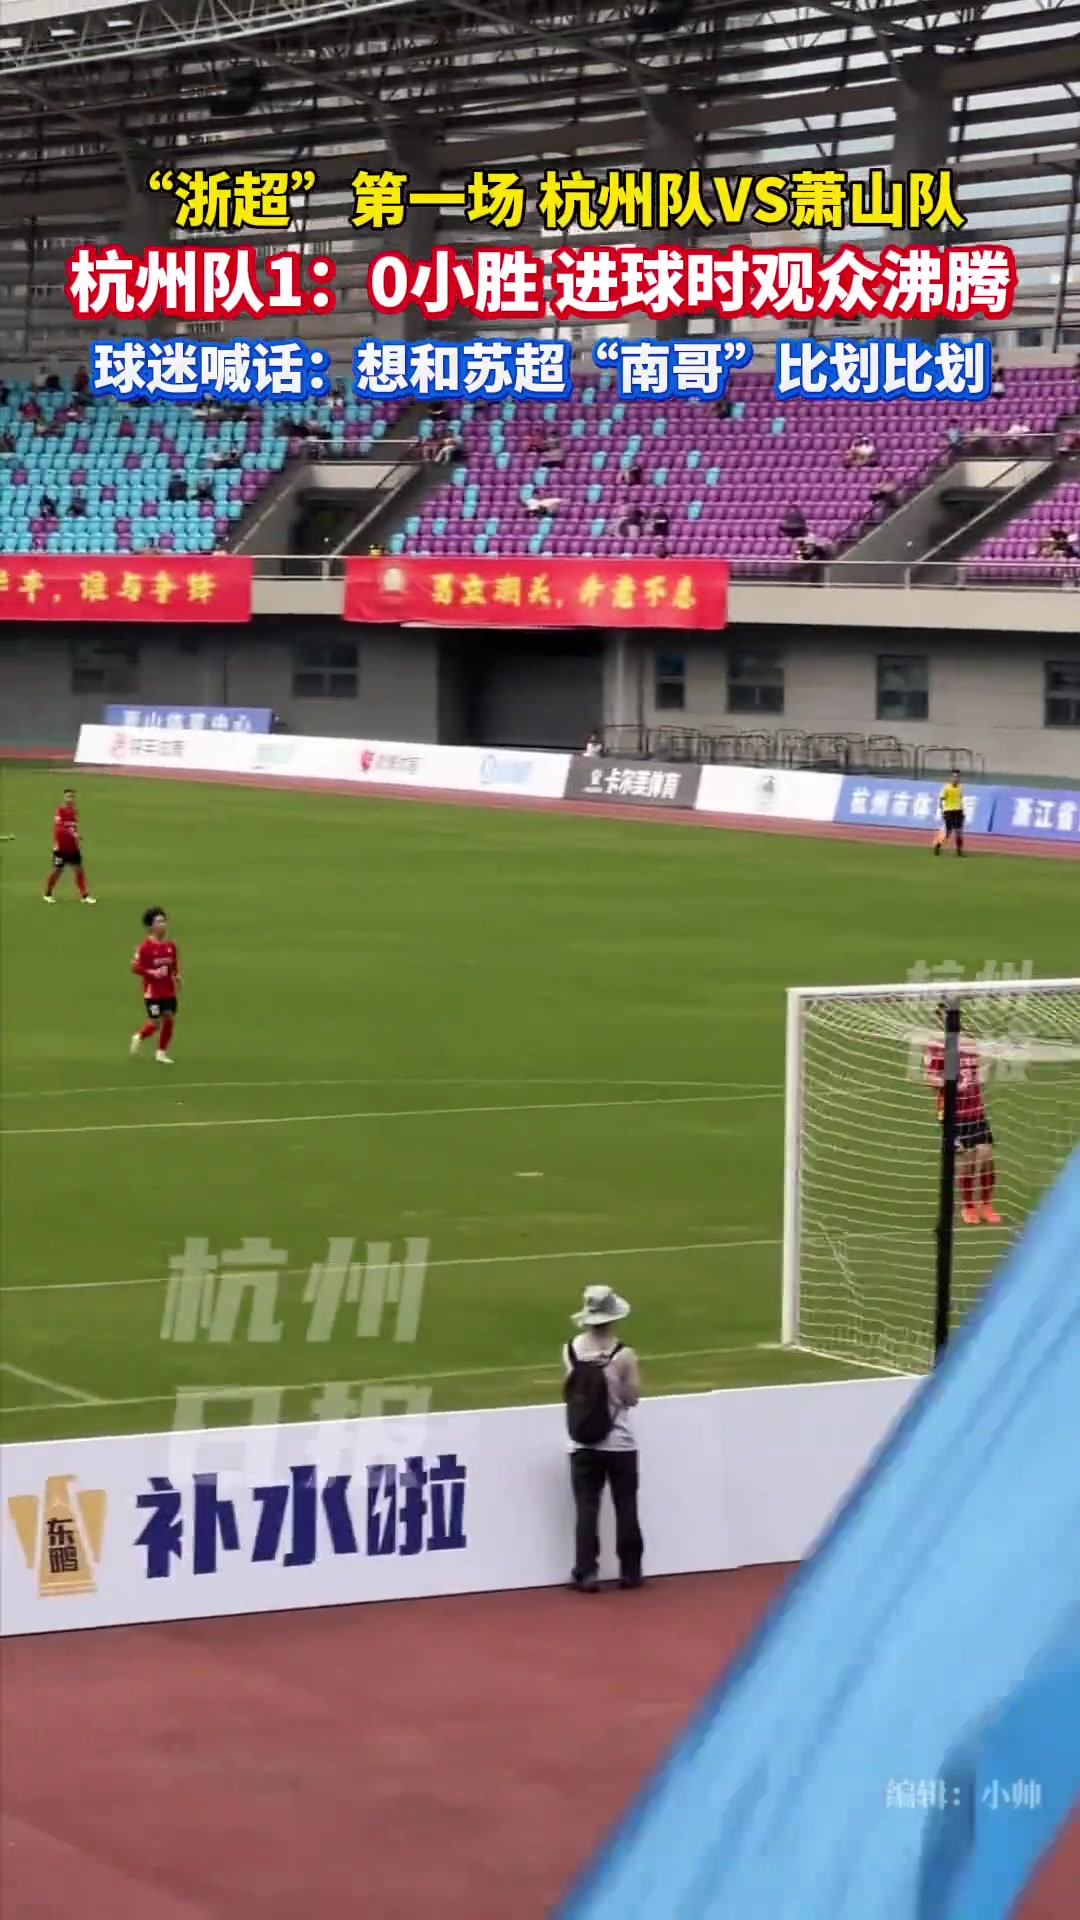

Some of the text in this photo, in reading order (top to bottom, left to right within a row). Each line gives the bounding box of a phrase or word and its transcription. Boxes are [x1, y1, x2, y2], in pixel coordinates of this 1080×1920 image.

[604, 767, 682, 799] 卡尔美体育
[134, 1454, 468, 1579] 补水啦
[46, 1517, 79, 1573] 东鹏
